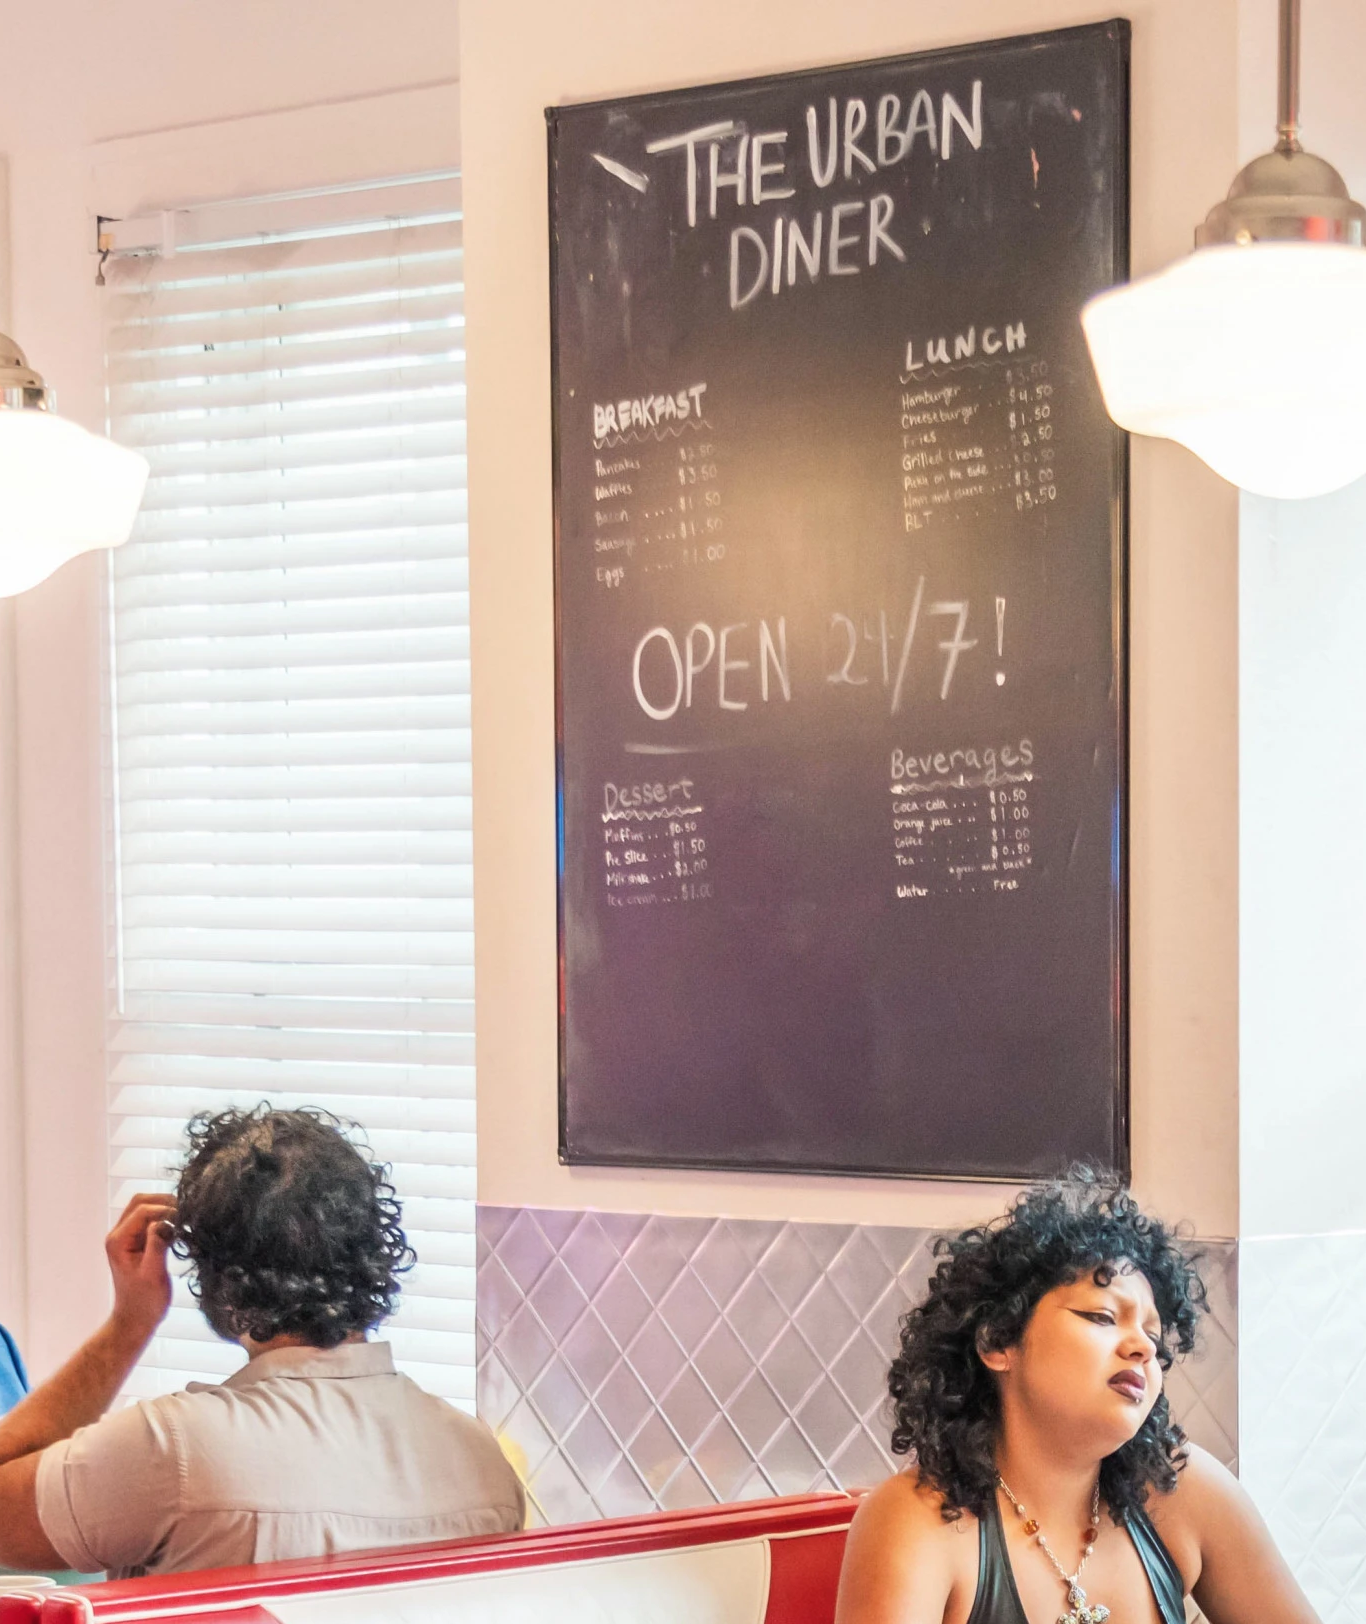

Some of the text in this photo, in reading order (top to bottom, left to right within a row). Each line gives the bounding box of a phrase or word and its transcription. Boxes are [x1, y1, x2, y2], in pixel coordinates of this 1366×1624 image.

[645, 78, 983, 228] THE URBAN
[729, 193, 907, 311] DINER
[905, 321, 1027, 372] LUNCH
[593, 382, 708, 439] BREAKFAST
[901, 385, 961, 410] Hamburger
[901, 384, 1054, 430] Cheeseburger $4.50
[902, 405, 1051, 449] Fries $1.50
[902, 449, 944, 472] Grilled
[905, 510, 933, 533] BLT
[631, 614, 792, 722] OPEN
[890, 738, 1035, 784] Beverages
[604, 777, 695, 813] Dessert
[989, 788, 1028, 805] $0.50
[929, 816, 954, 832] juice
[990, 805, 1030, 823] $1.00
[895, 854, 916, 867] Tea
[896, 878, 1020, 899] Water Free
